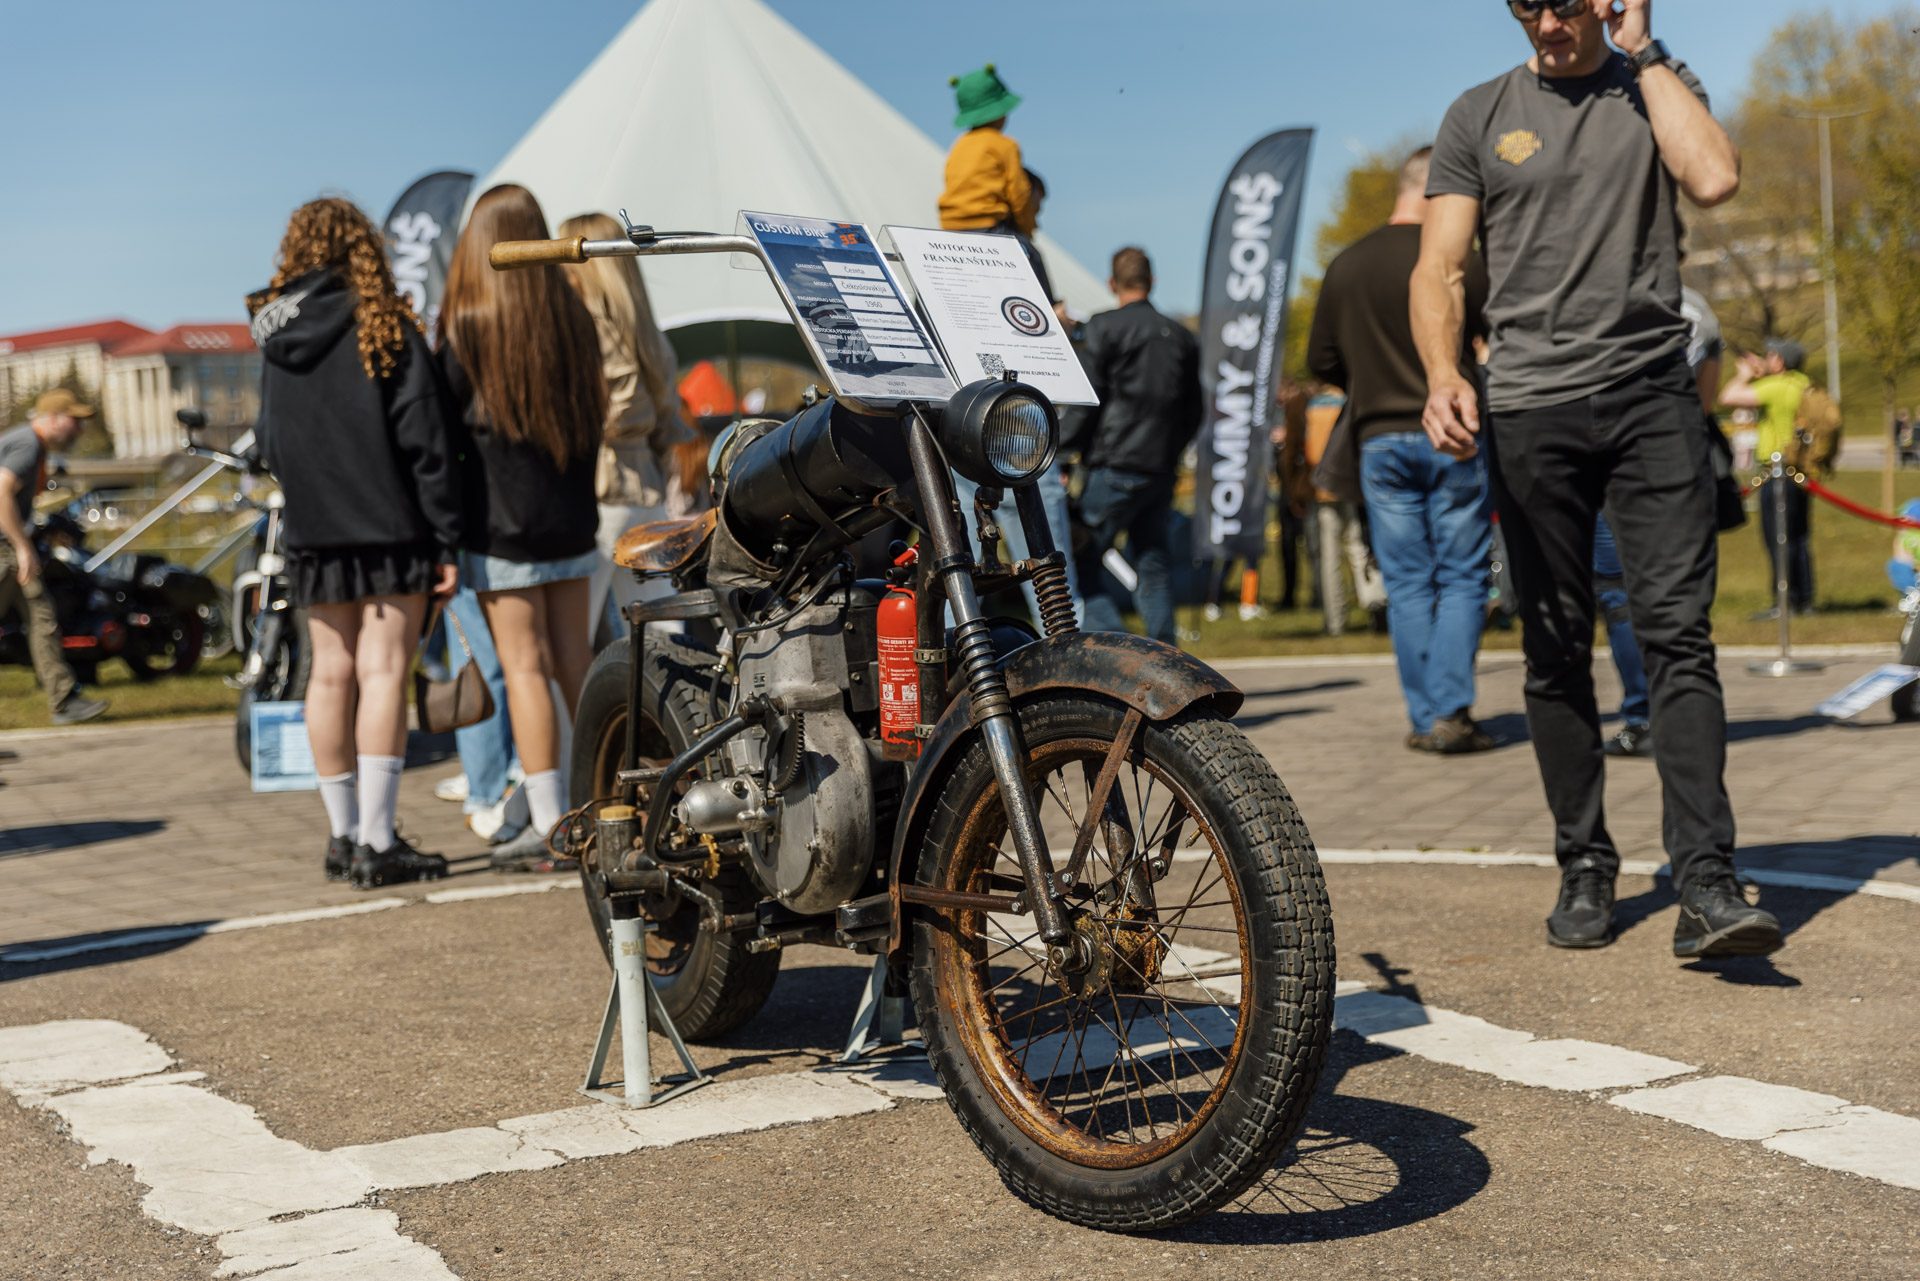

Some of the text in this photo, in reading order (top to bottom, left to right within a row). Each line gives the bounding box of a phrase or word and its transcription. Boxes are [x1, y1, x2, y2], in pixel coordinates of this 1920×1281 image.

[754, 222, 829, 238] CUSTOM BIKE
[928, 242, 1000, 255] MOTOCIKLAS
[923, 254, 1016, 269] FRANKENŠTEINAS
[1221, 312, 1262, 351] &
[1210, 362, 1254, 544] TOMMY
